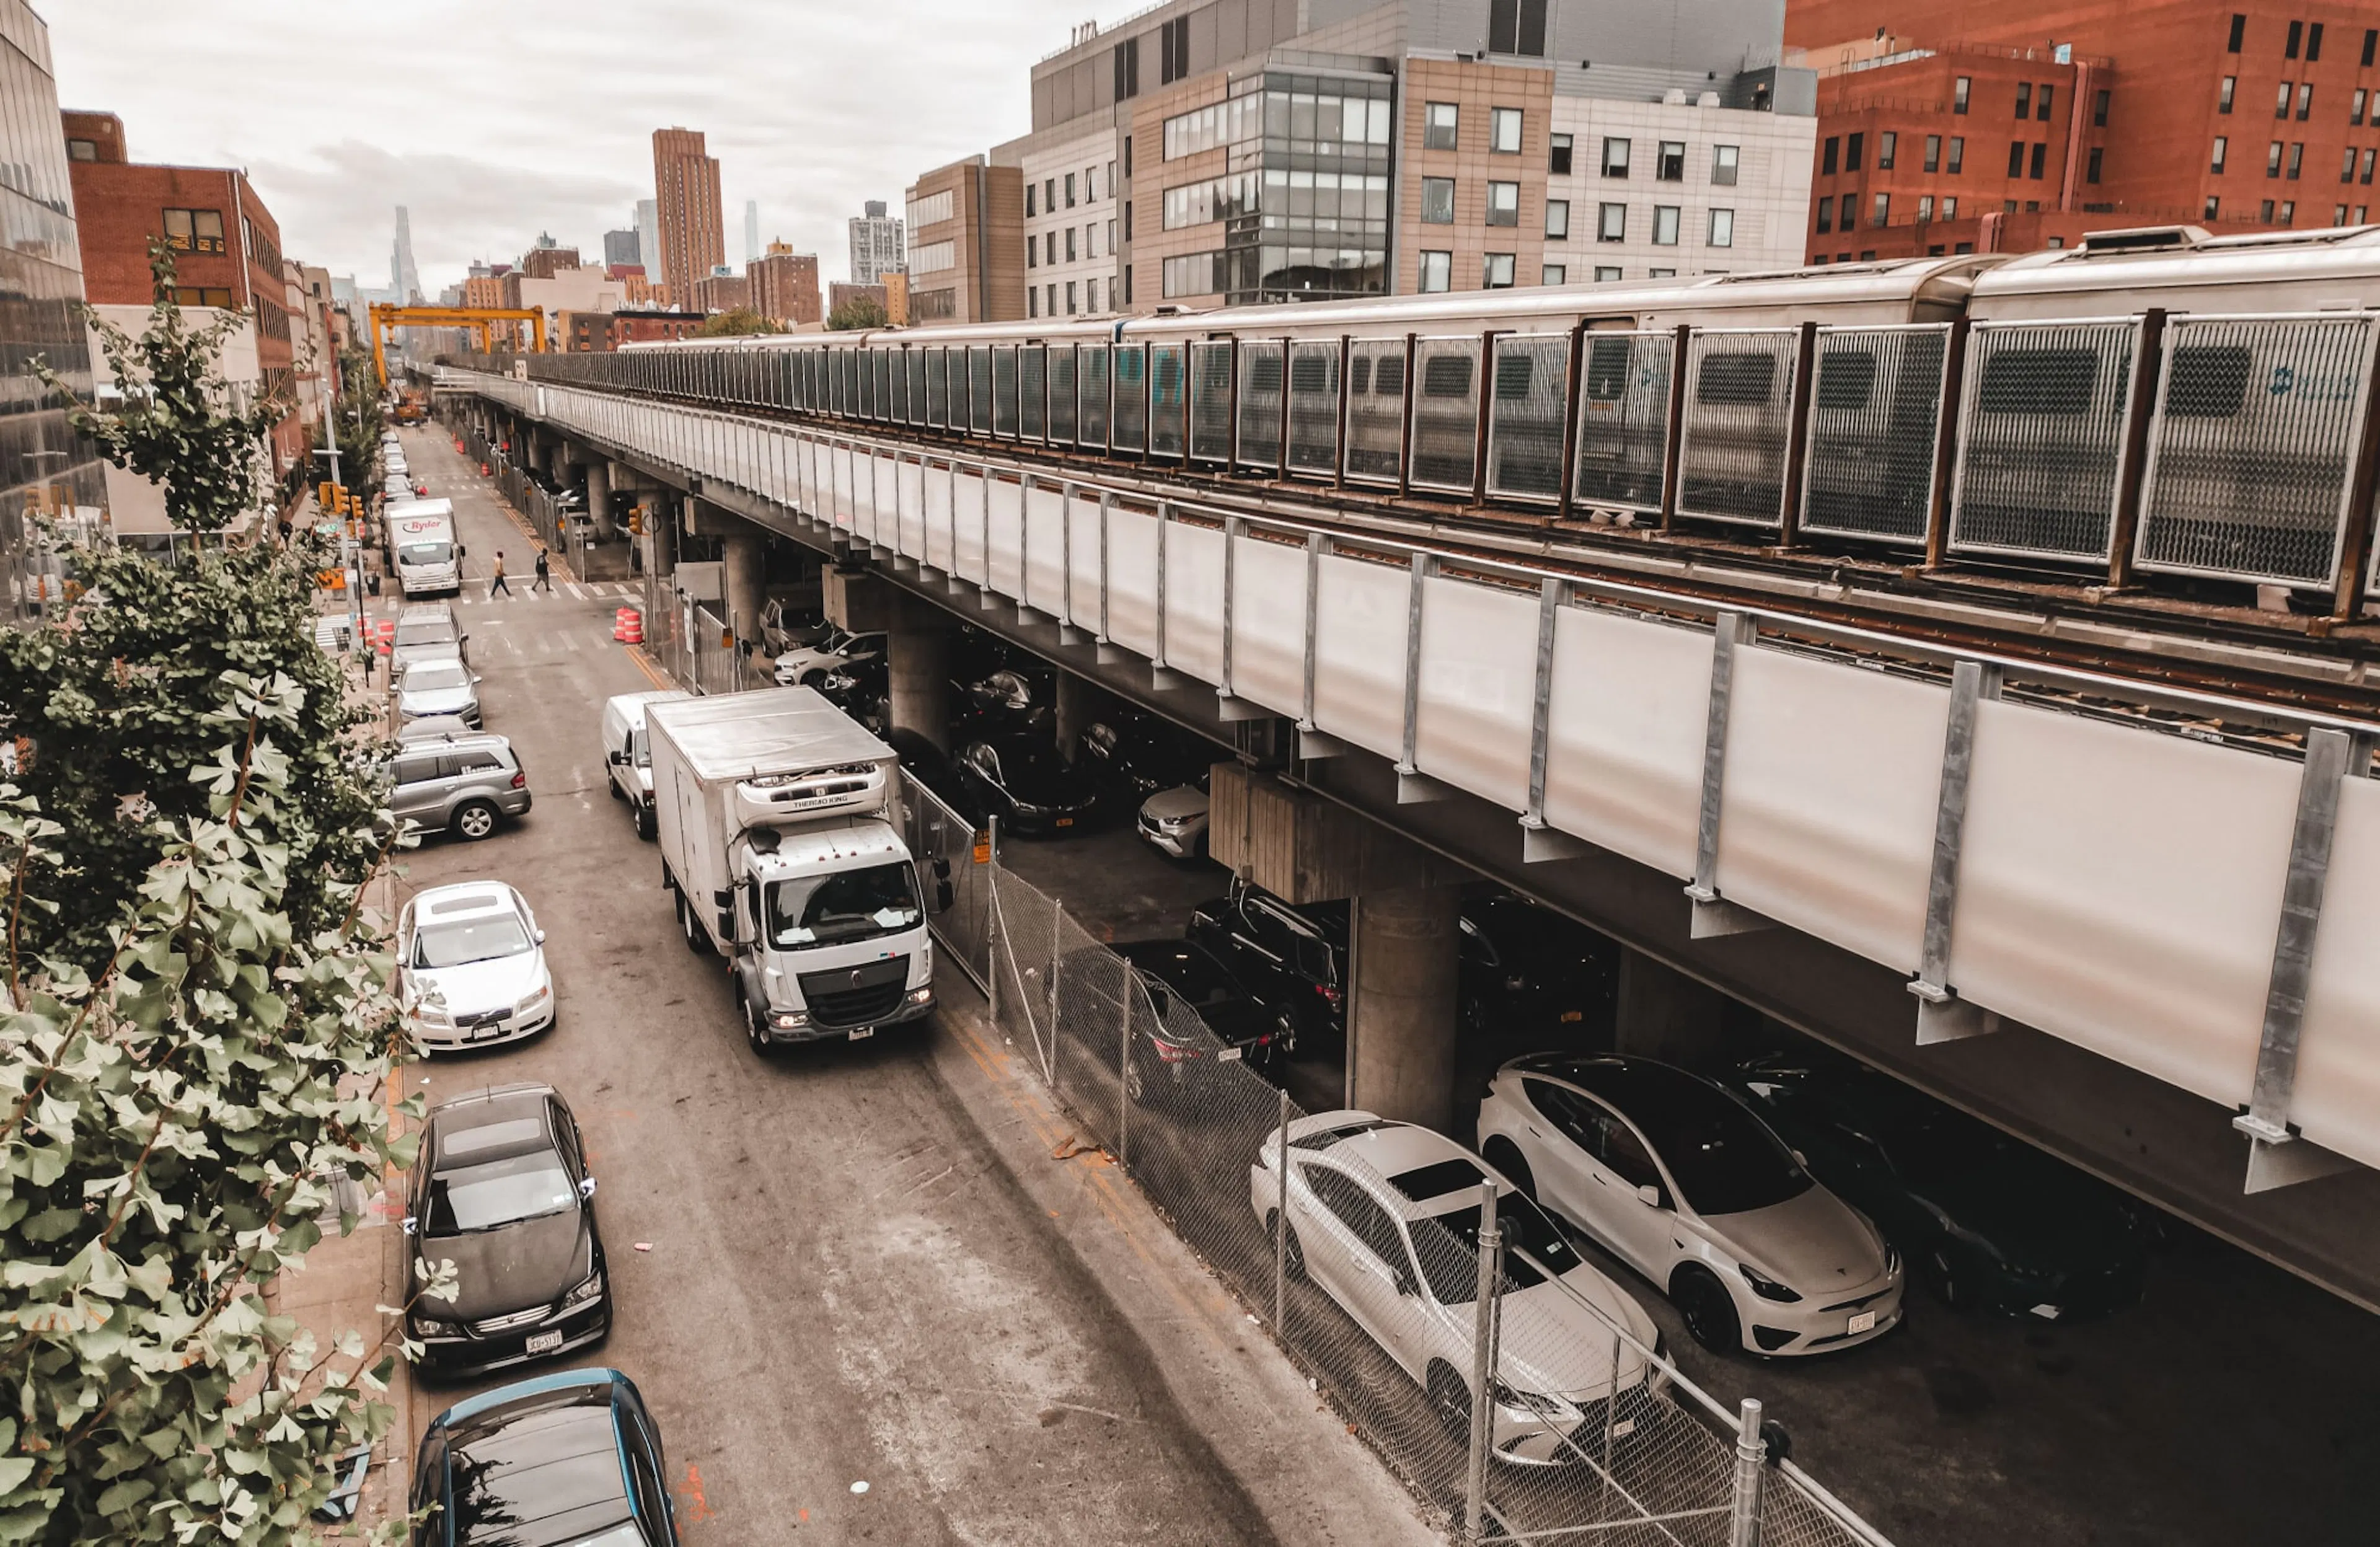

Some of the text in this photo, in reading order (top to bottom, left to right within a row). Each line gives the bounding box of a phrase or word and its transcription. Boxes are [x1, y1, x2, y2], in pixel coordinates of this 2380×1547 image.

[411, 521, 441, 531] Ryder
[794, 795, 848, 808] THERMO KING
